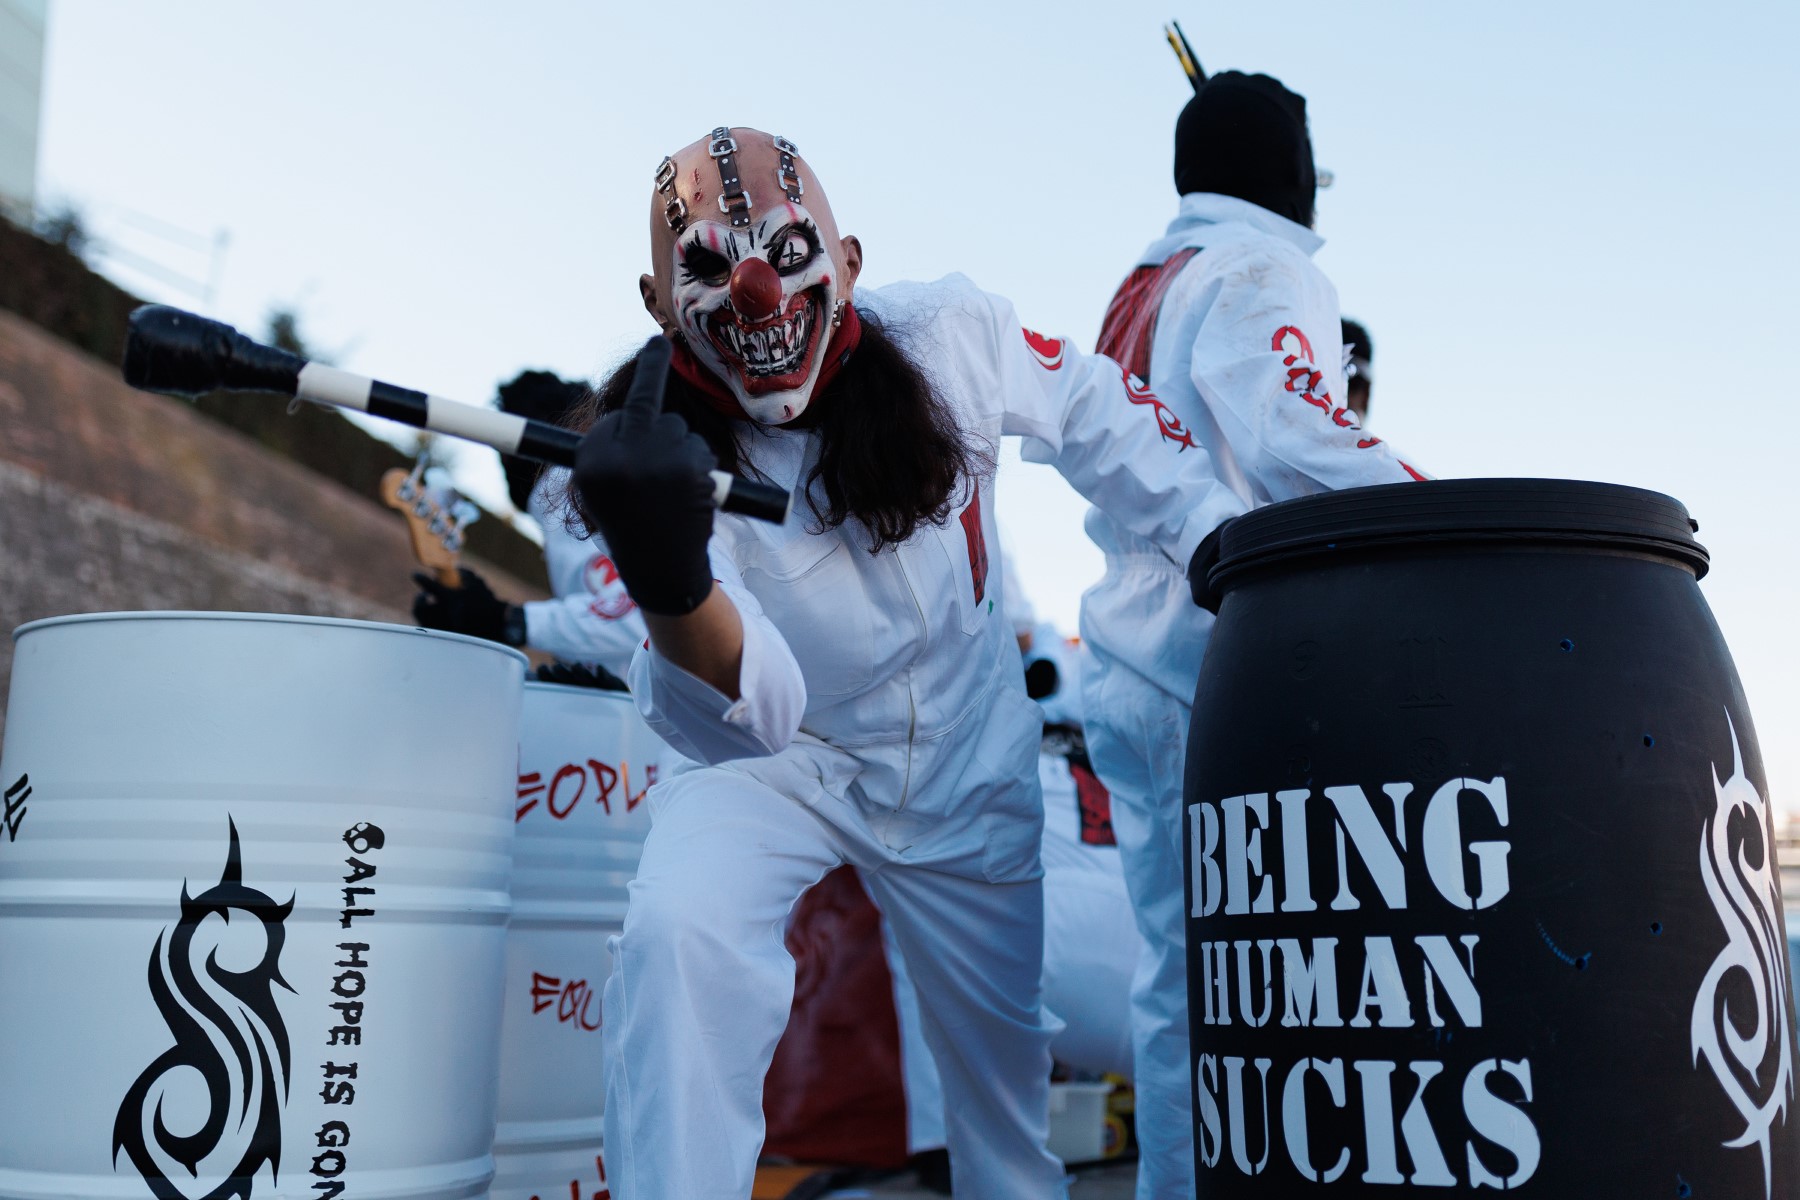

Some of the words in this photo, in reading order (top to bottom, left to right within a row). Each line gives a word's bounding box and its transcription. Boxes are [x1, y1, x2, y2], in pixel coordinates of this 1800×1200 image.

[339, 856, 377, 929] ALL
[1188, 776, 1512, 918] BEING
[326, 942, 370, 1046] HOPE
[1201, 934, 1482, 1028] HUMAN
[318, 1061, 358, 1105] IS
[1198, 1053, 1541, 1190] SUCKS
